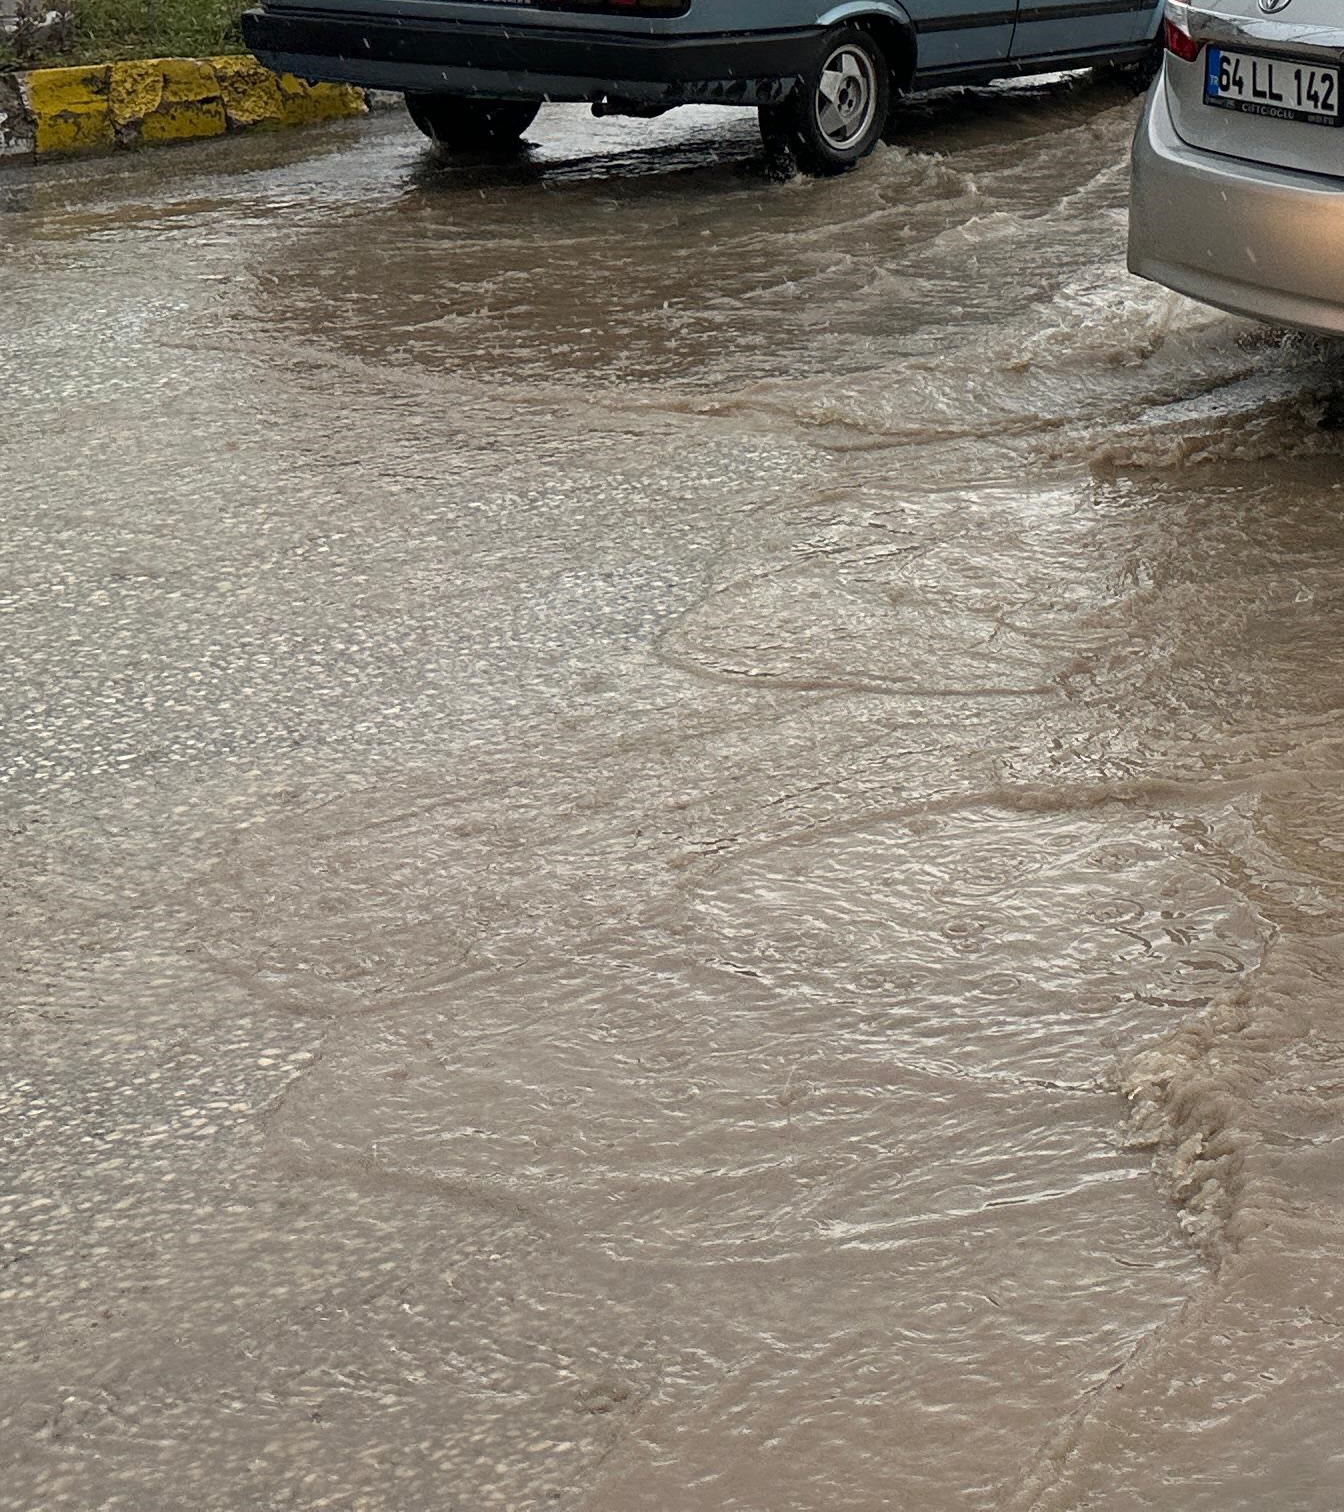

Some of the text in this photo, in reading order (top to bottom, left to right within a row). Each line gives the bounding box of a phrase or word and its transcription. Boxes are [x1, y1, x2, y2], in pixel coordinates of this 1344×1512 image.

[1209, 55, 1335, 111] TR 64 LL 142
